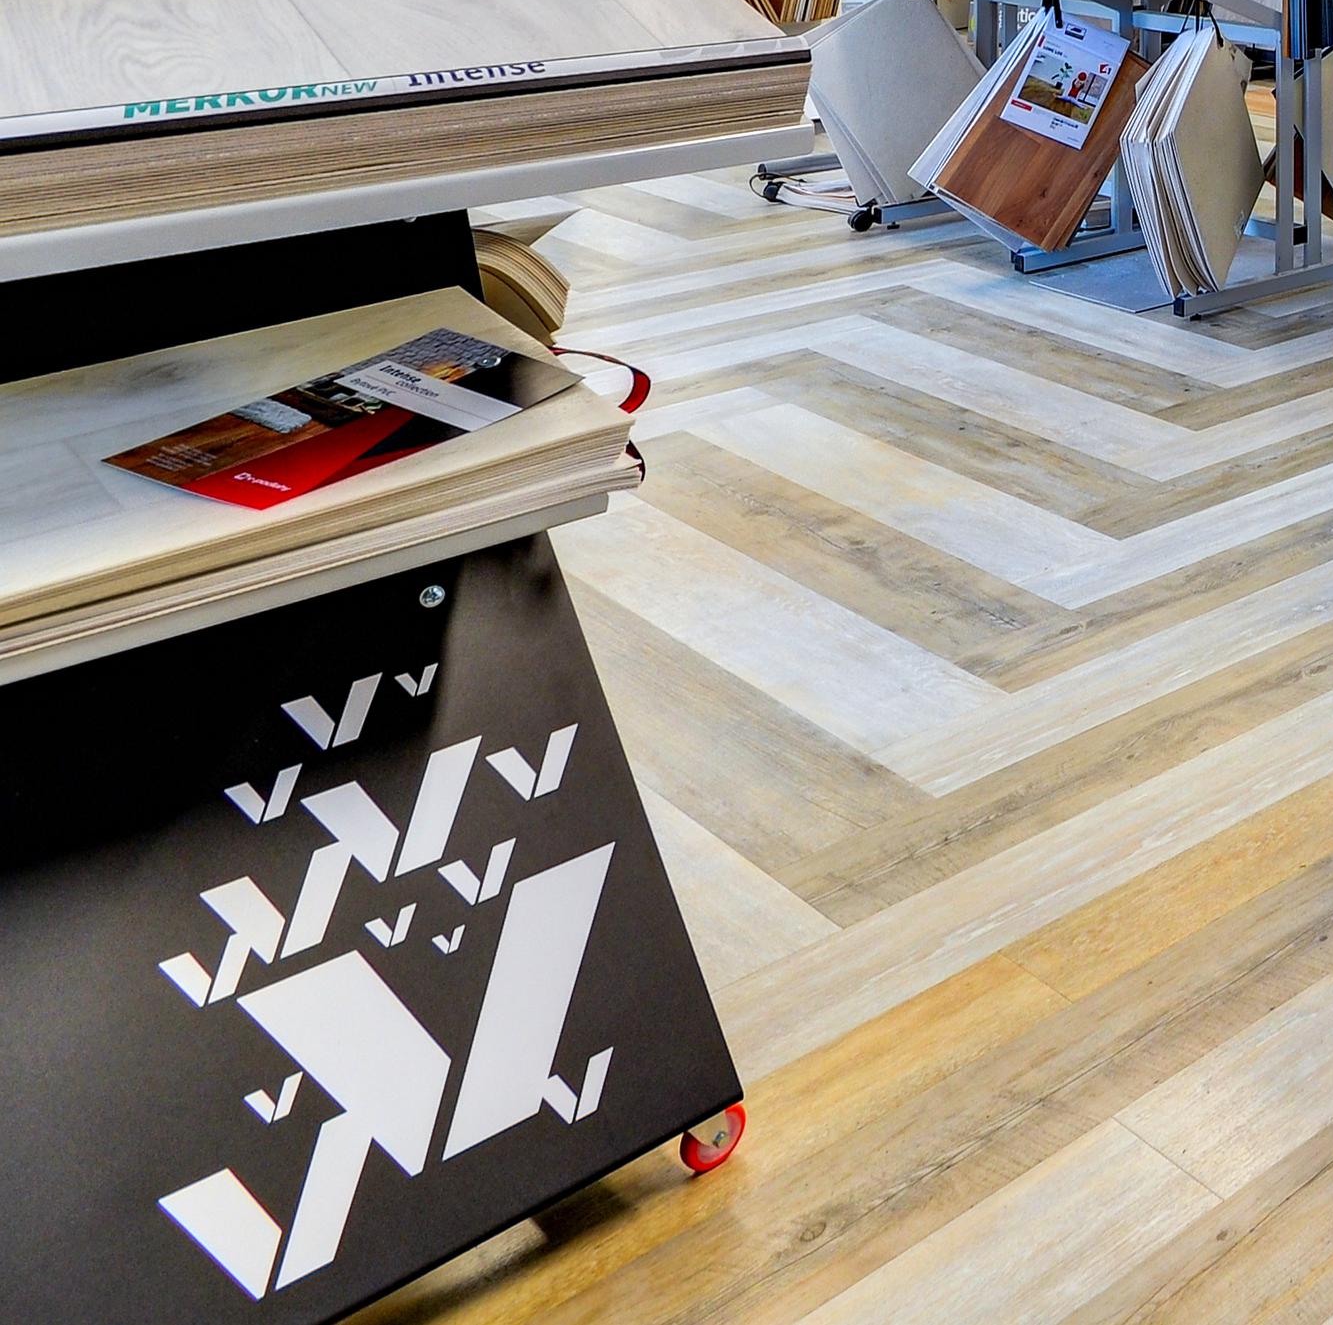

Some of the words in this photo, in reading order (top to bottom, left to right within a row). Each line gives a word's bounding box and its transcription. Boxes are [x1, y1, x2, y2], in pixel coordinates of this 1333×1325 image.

[320, 81, 378, 97] NEW
[379, 365, 422, 384] Intense
[395, 380, 440, 398] collection
